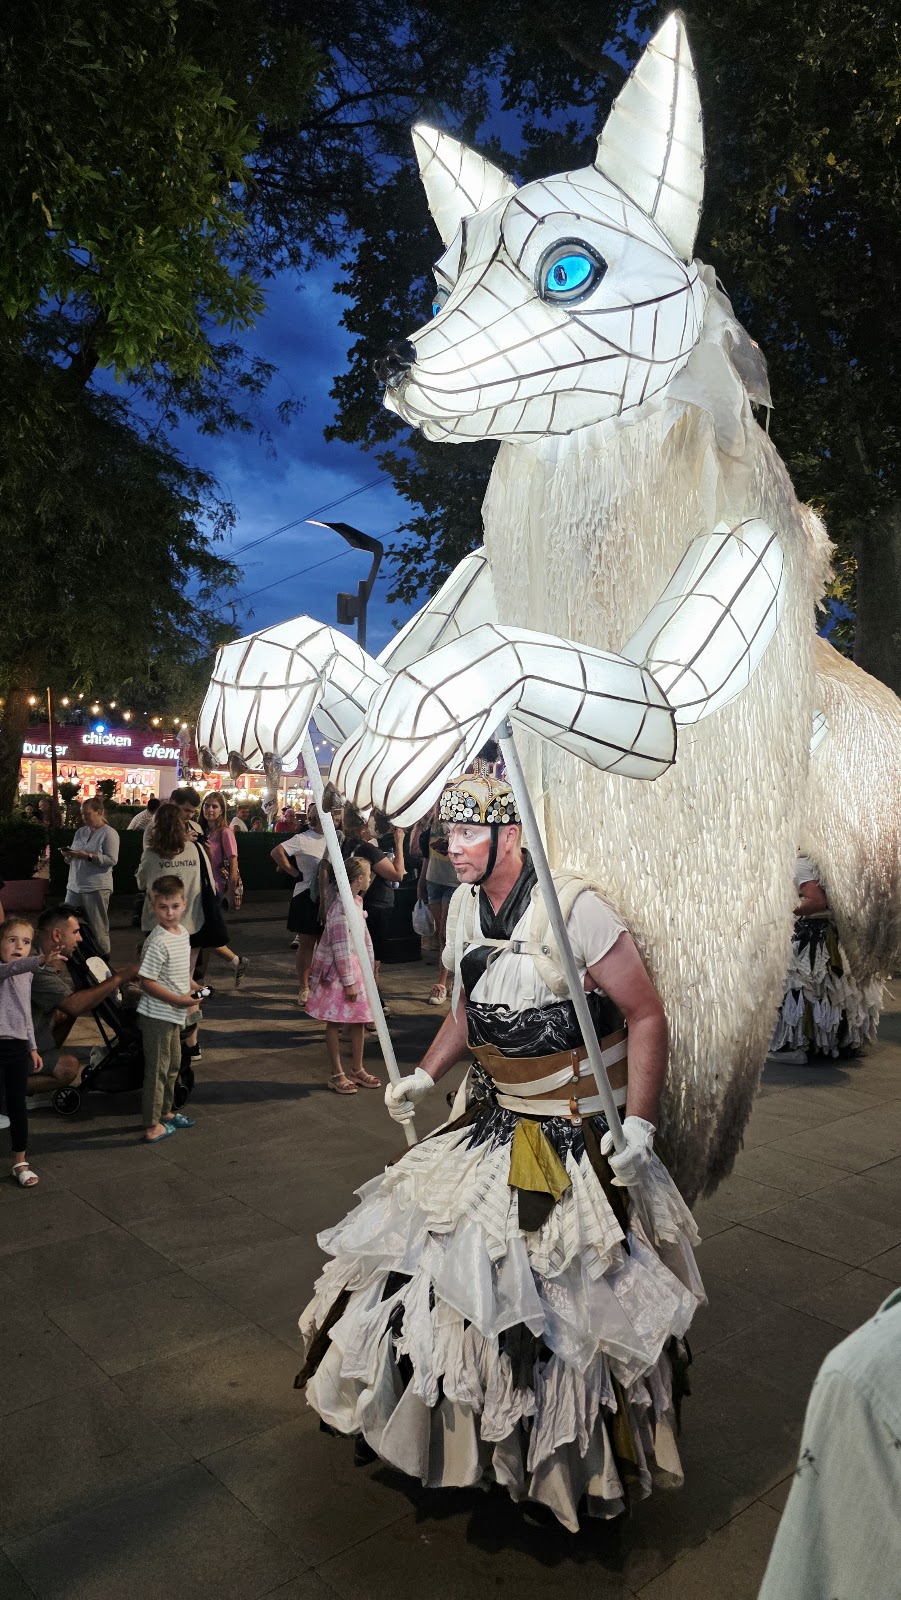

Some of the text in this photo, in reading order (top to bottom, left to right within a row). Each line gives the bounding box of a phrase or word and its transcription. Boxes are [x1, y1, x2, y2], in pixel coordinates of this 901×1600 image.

[82, 726, 132, 747] chicken
[22, 740, 69, 758] burger
[158, 860, 198, 869] VOLUNTAR
